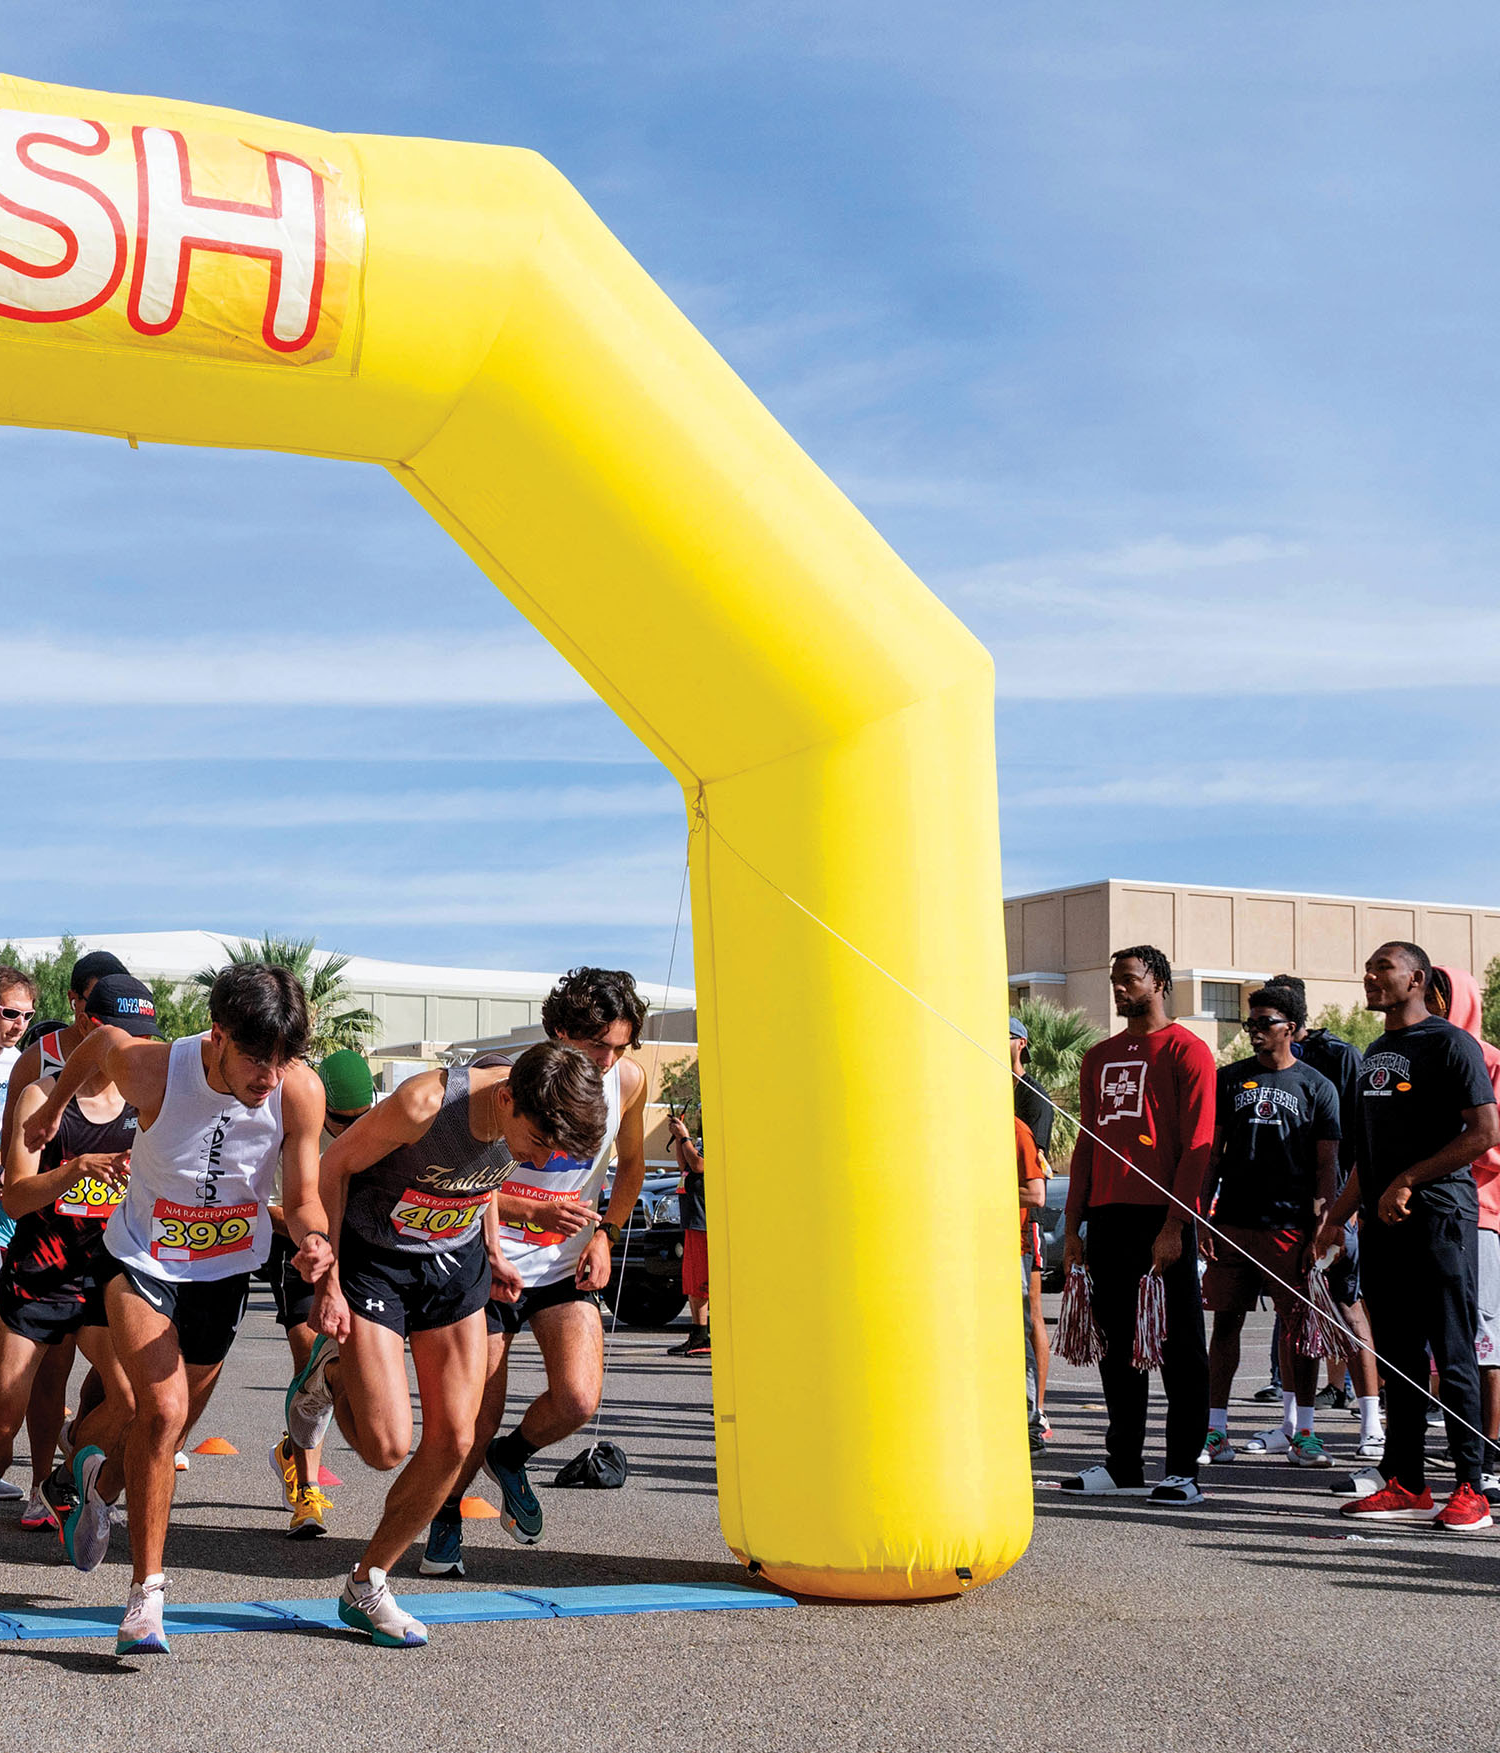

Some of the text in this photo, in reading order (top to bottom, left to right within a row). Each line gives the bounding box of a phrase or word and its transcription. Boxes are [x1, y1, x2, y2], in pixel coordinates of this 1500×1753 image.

[1235, 1087, 1299, 1116] BASKETBALL
[412, 1195, 431, 1206] NM
[510, 1185, 525, 1196] NM
[163, 1204, 255, 1219] NM RACEFUNDING
[399, 1204, 483, 1234] 401
[158, 1218, 250, 1251] 399
